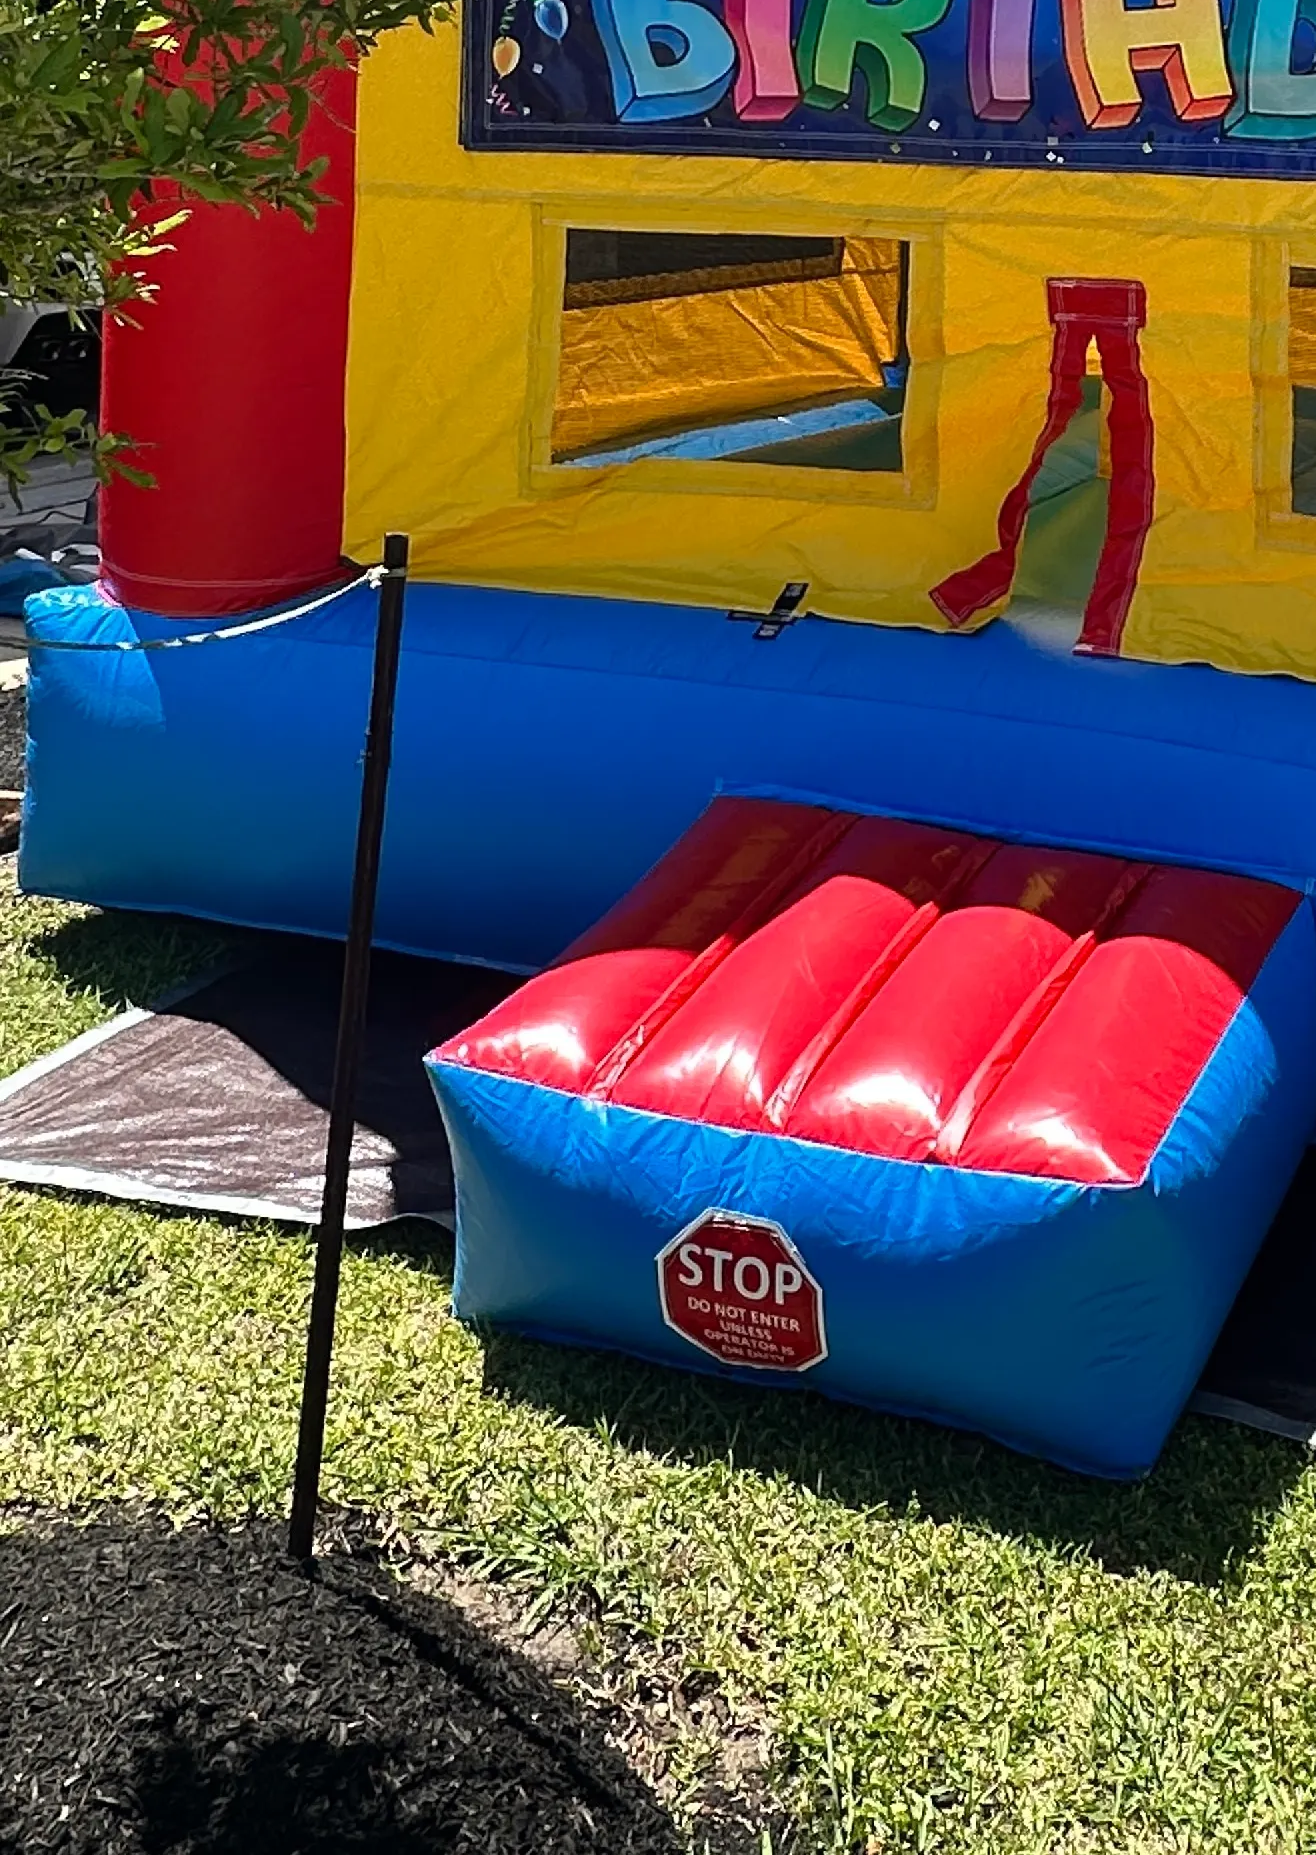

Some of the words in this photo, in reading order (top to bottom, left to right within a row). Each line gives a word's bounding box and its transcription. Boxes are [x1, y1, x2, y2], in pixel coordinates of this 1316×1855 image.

[678, 1243, 803, 1306] STOP
[687, 1296, 711, 1314] DO
[714, 1302, 748, 1320] NOT
[751, 1310, 801, 1333] ENTER
[719, 1319, 773, 1342] UNLESS
[703, 1328, 778, 1354] OPERATOR
[781, 1345, 796, 1357] IS
